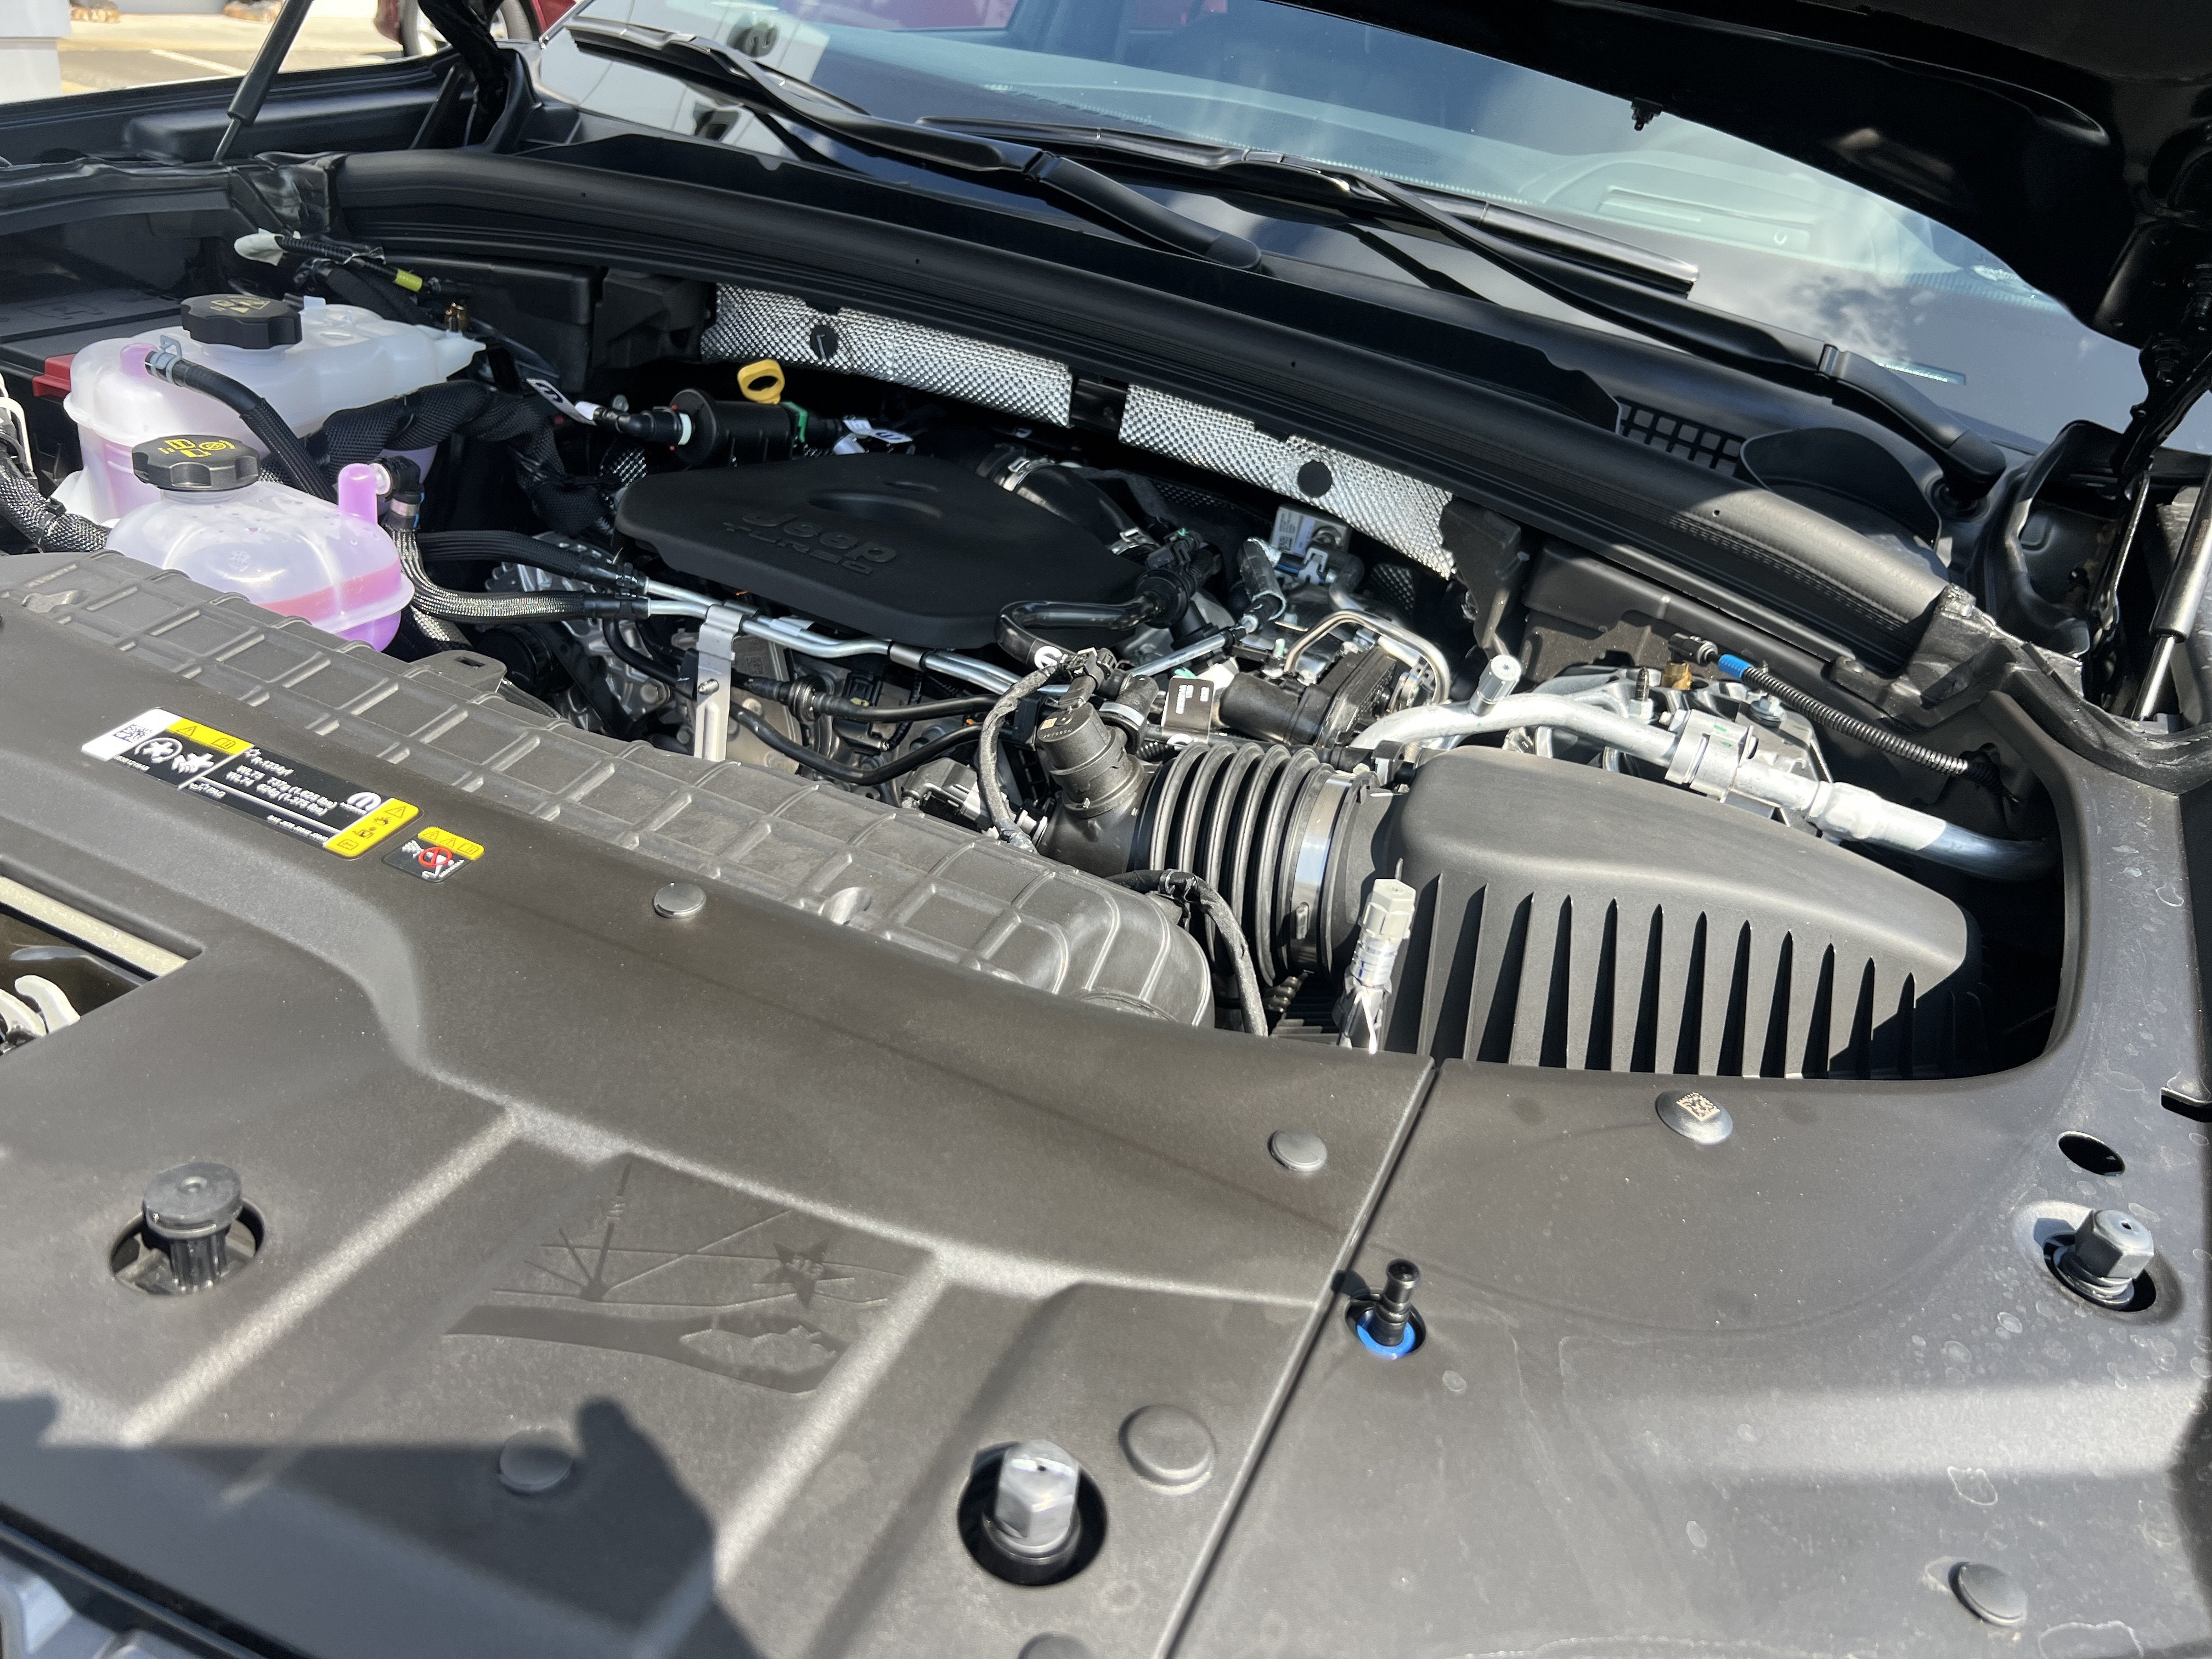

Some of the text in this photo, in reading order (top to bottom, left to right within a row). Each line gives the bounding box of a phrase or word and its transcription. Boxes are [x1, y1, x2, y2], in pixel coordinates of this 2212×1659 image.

[742, 513, 898, 563] Jeep
[236, 765, 265, 780] WL75
[267, 777, 291, 792] 737g
[288, 786, 321, 803] (1.625
[317, 796, 338, 810] lbs)
[251, 757, 294, 776] R-1234yf
[208, 787, 226, 798] PAG
[225, 771, 255, 787] WL74
[256, 783, 281, 799] 624g
[278, 793, 311, 809] (1.375
[307, 803, 329, 817] lbs)
